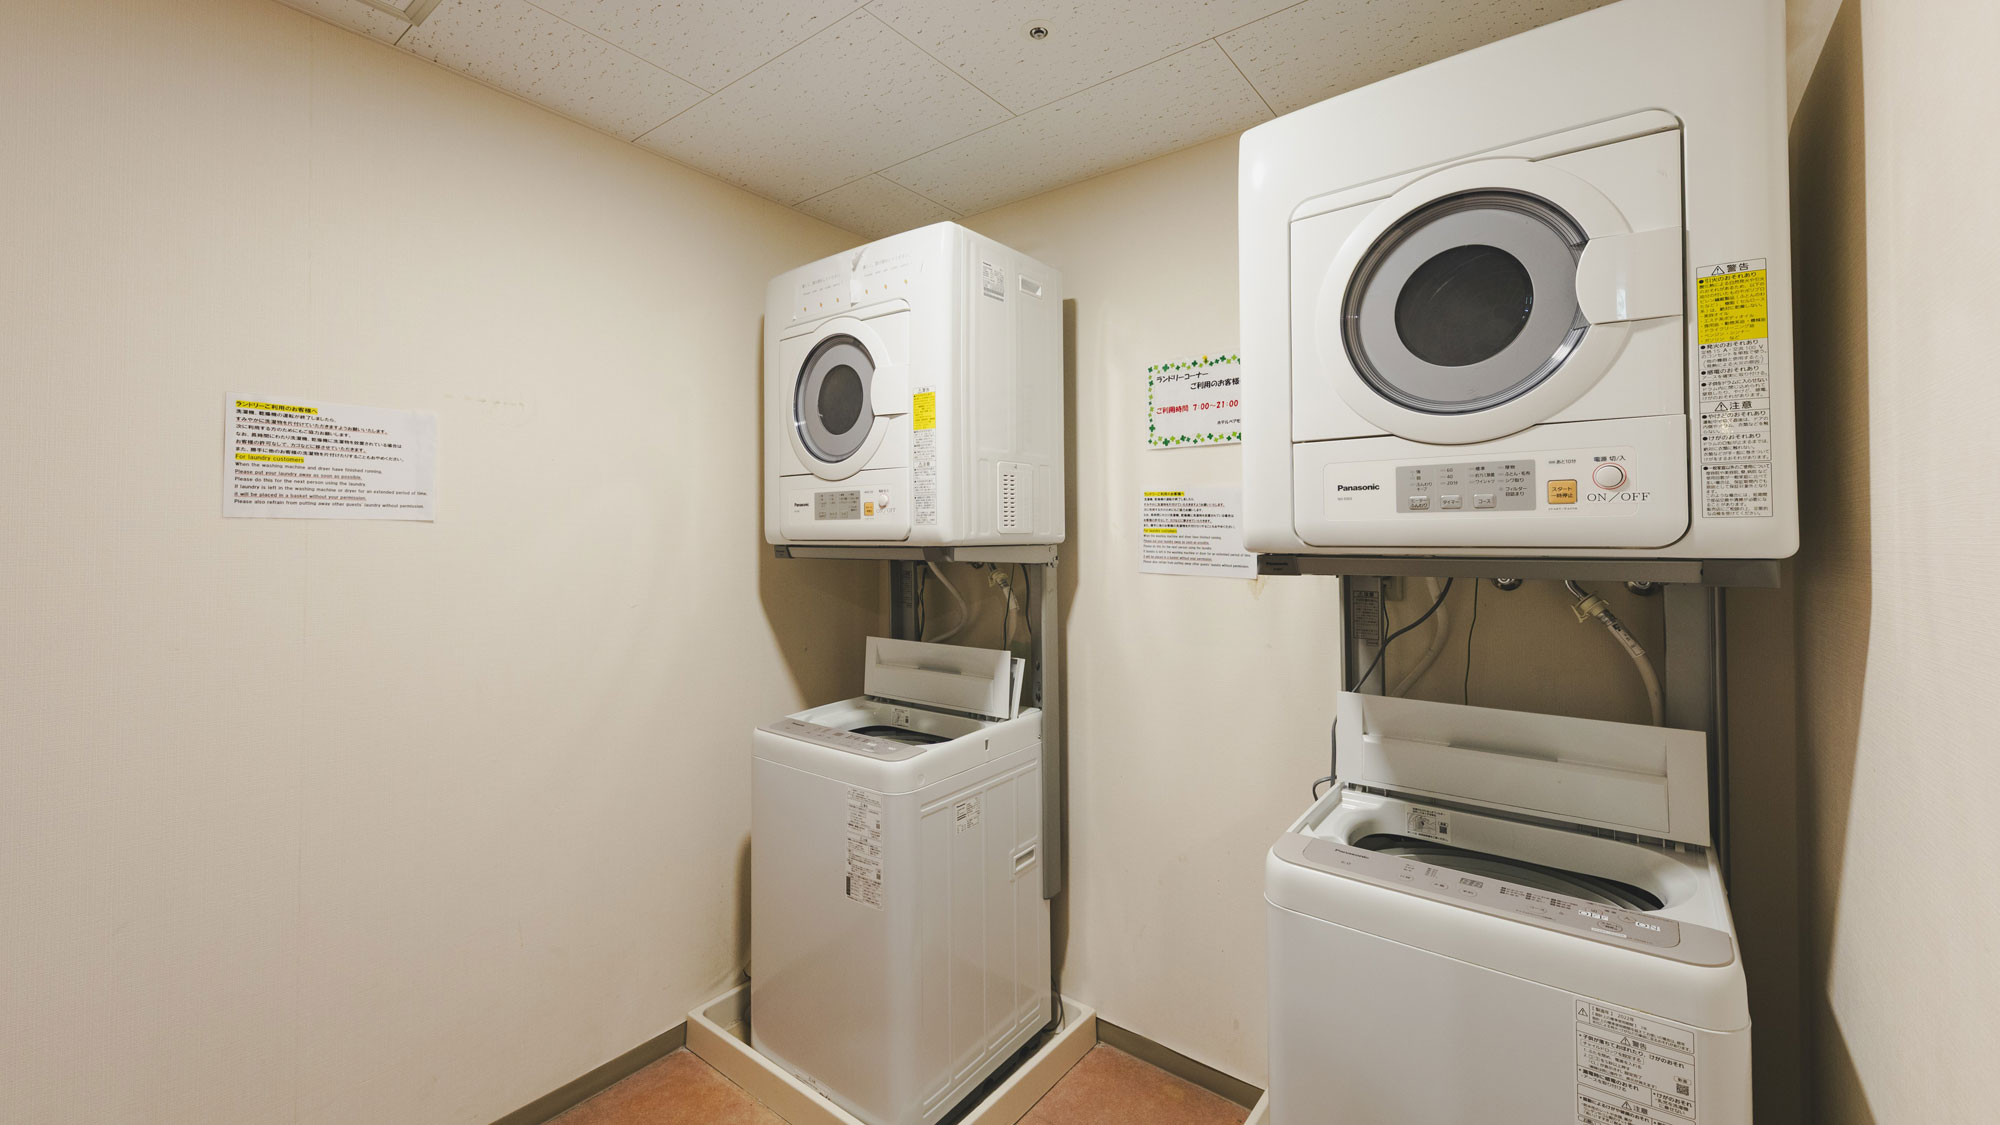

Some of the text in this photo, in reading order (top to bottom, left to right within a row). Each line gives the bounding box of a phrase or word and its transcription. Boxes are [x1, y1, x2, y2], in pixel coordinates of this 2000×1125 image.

[1156, 372, 1208, 383] ランドリーコーナー
[1190, 378, 1240, 390] ご利用のお客様
[236, 401, 318, 414] ランドリーご利用のお客様へ
[1156, 405, 1189, 414] ご利用時間
[1730, 401, 1752, 410] 注意
[248, 454, 271, 462] laundry
[1337, 483, 1380, 491] Panasonic
